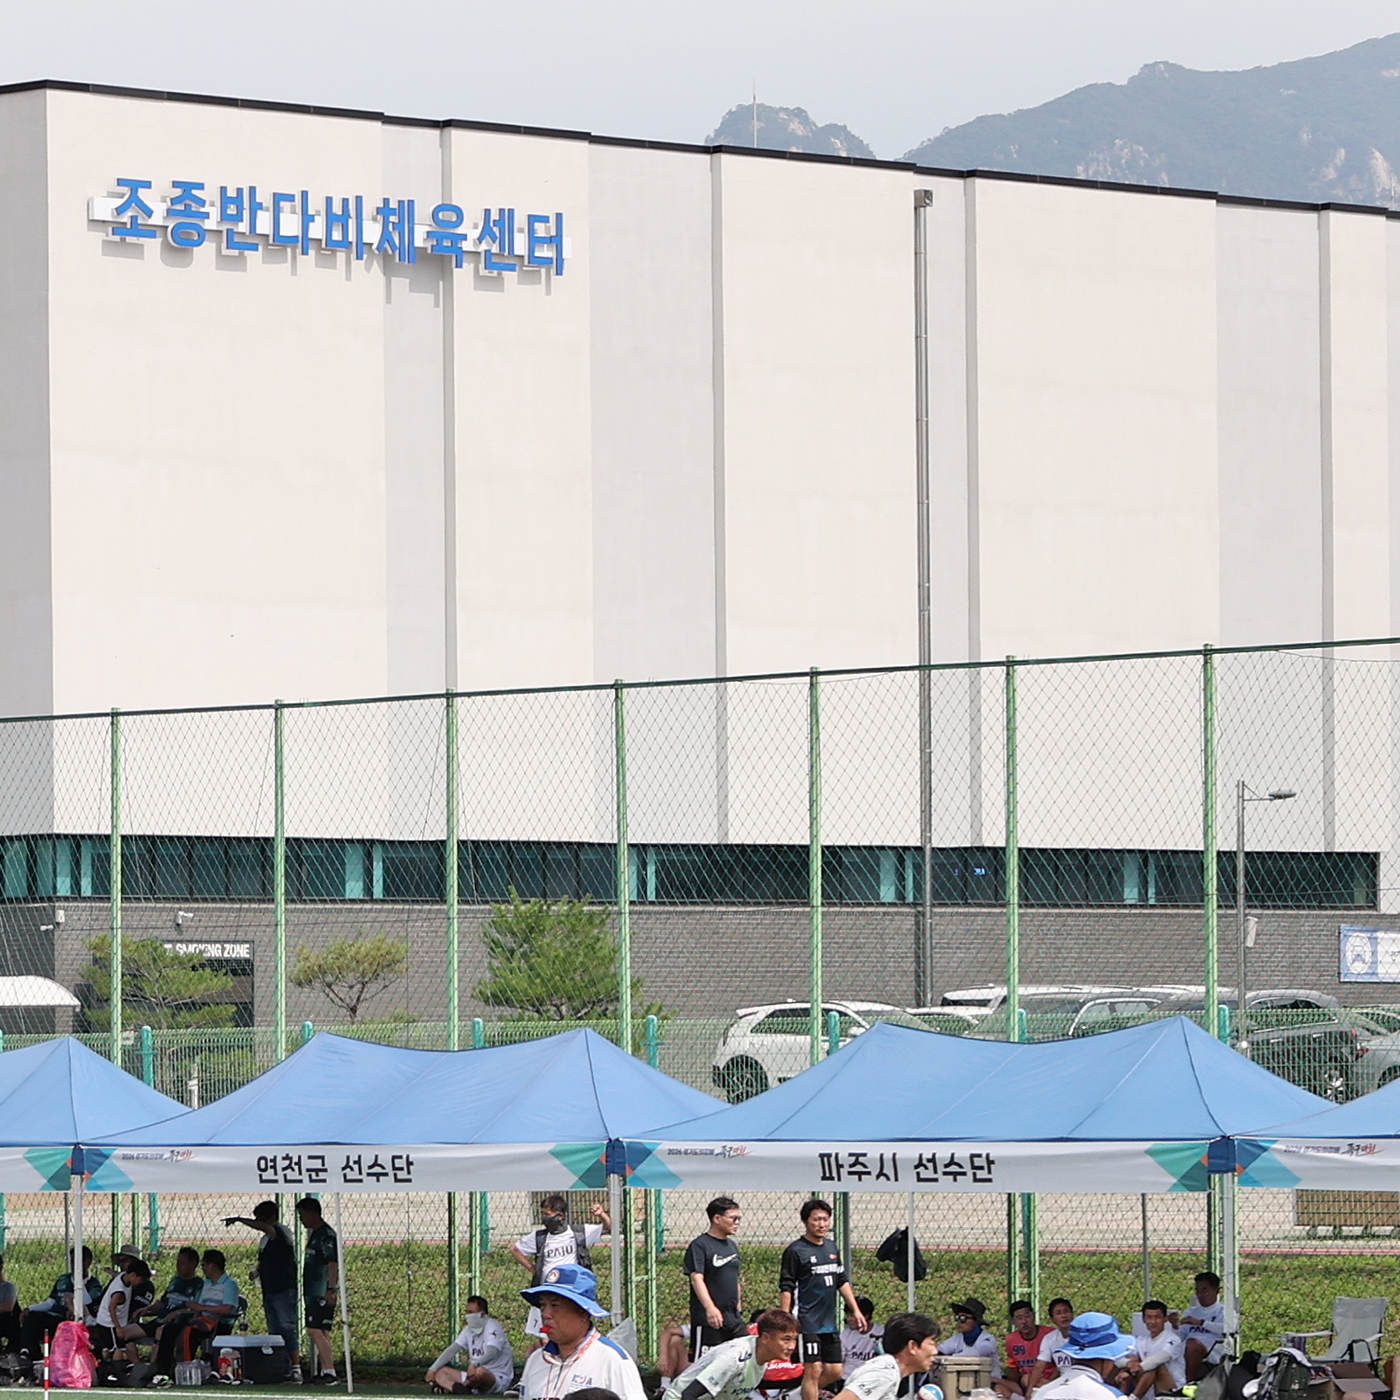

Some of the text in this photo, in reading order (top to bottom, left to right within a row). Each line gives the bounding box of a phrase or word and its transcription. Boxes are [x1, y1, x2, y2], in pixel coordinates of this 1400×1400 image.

[111, 177, 563, 276] 조종반다비체육센터
[256, 1153, 414, 1184] 연천군 선수단
[818, 1152, 996, 1184] 파주시 선수단
[546, 1246, 573, 1257] PAJU
[824, 1275, 834, 1287] 11
[805, 1342, 819, 1355] 11
[1057, 1356, 1070, 1365] PA
